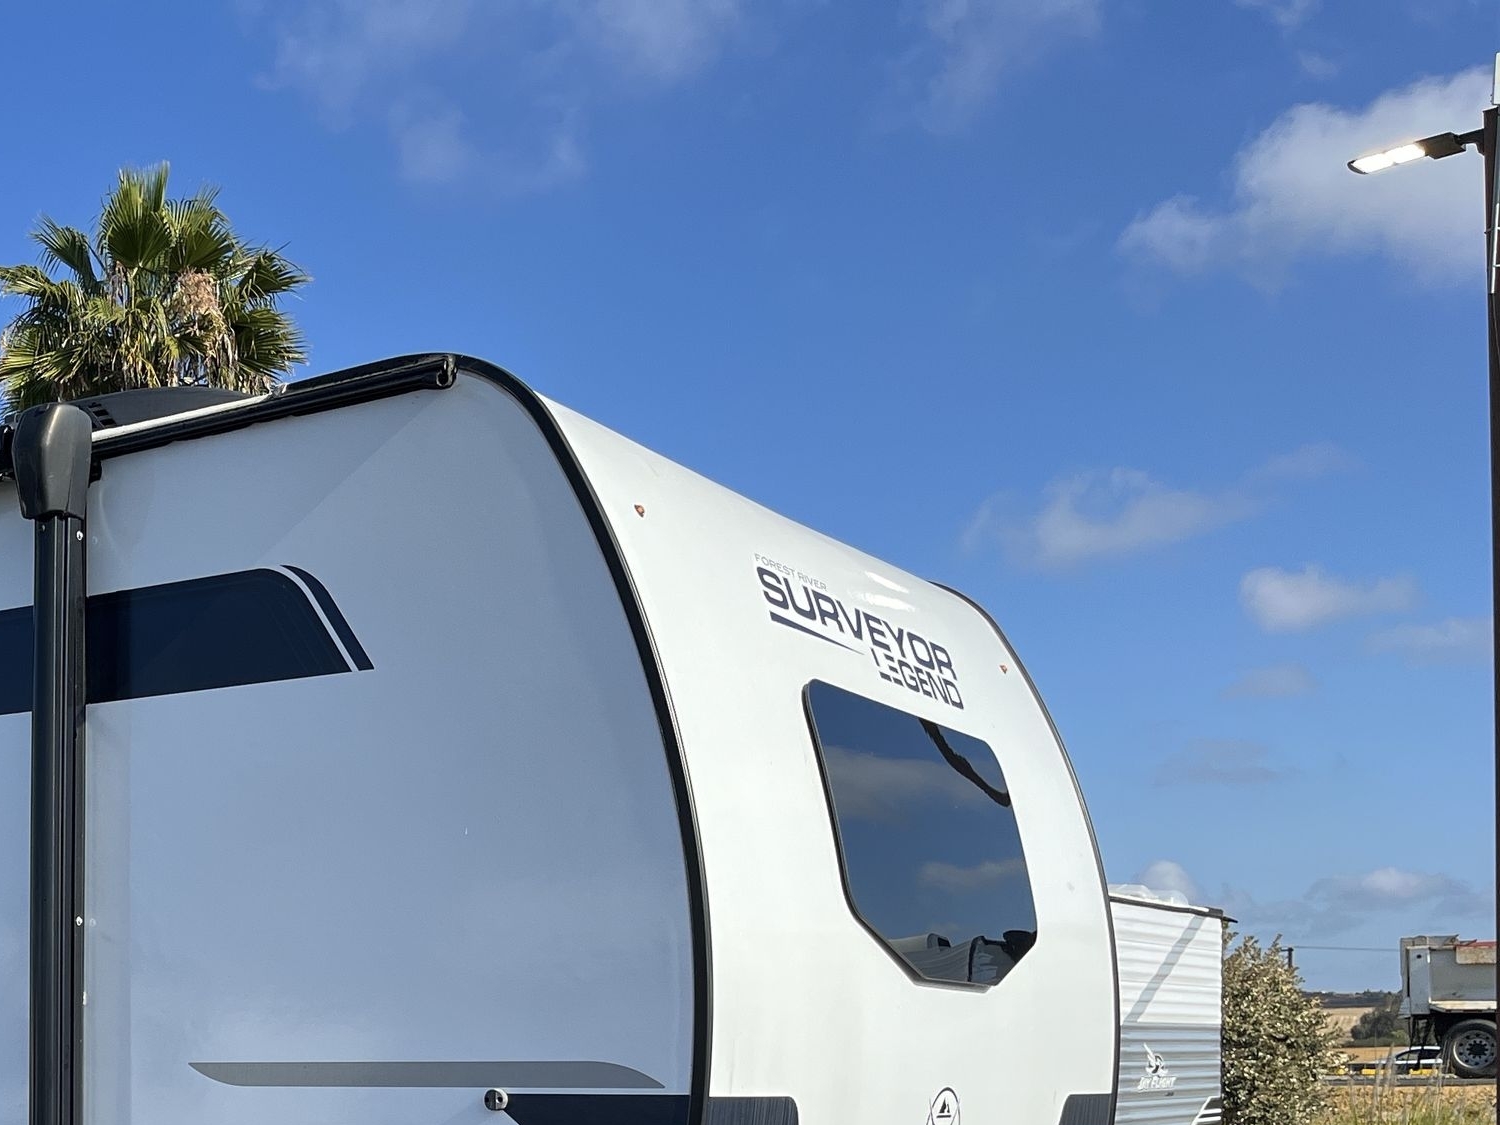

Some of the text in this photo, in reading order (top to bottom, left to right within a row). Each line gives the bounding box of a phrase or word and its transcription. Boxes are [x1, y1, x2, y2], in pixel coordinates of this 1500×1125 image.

[754, 553, 828, 591] FOREST RIVER
[756, 566, 958, 681] SURVEYOR
[869, 647, 964, 710] LEGEND
